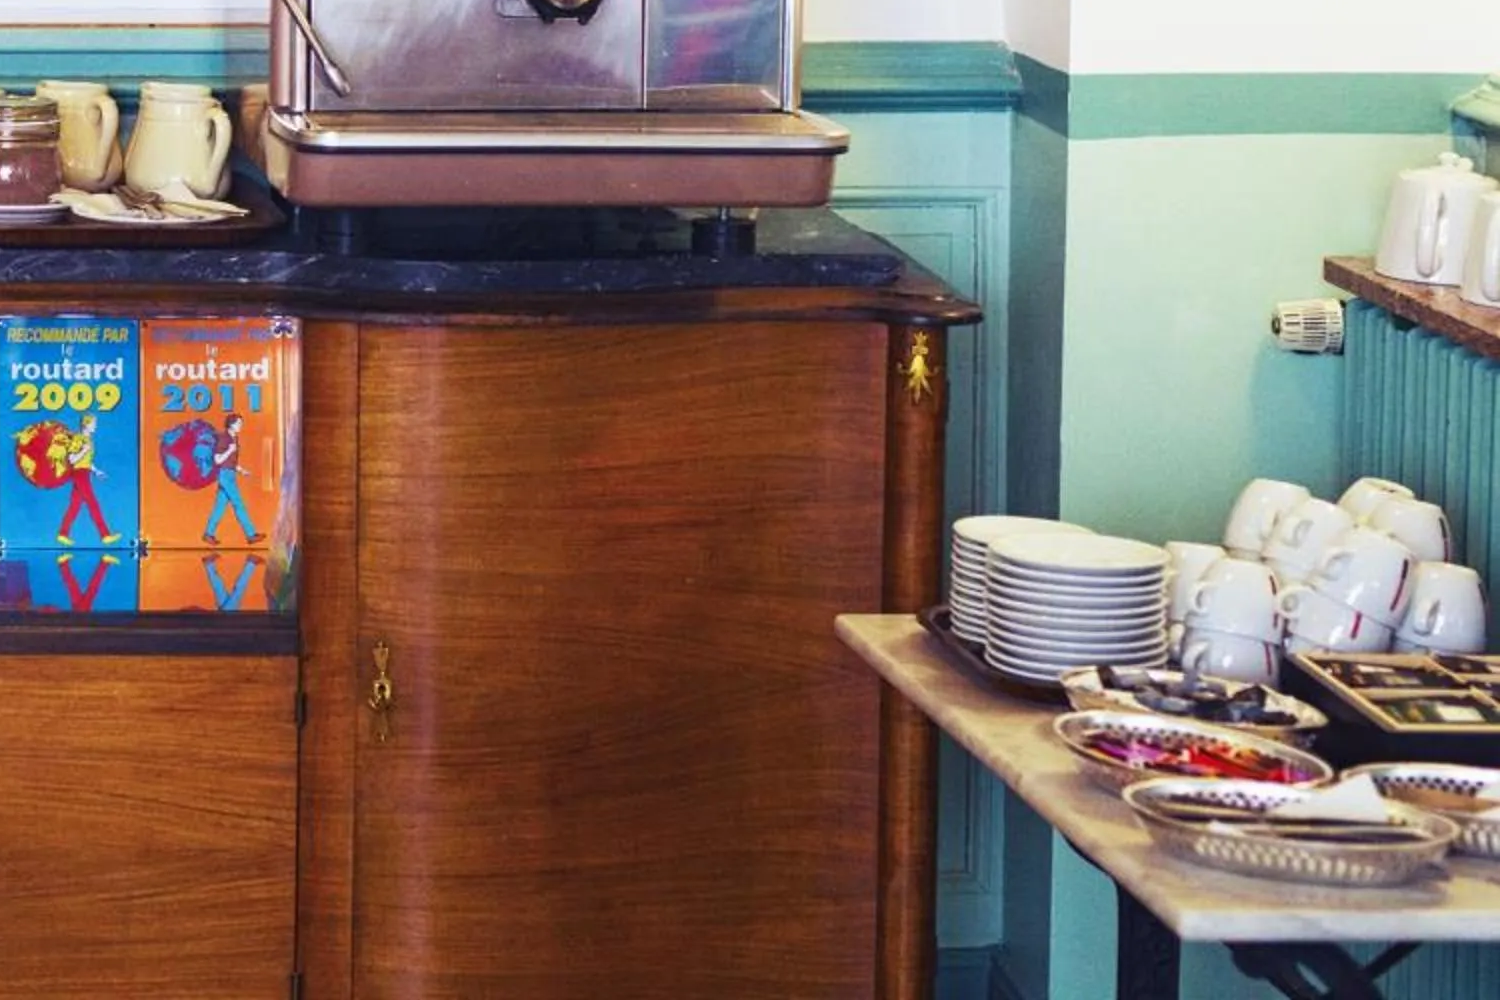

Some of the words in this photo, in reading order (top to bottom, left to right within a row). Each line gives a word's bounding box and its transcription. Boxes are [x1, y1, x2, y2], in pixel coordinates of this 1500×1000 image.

[103, 327, 129, 342] PAR
[11, 357, 124, 380] routard
[155, 356, 269, 380] routard
[12, 382, 123, 412] 2009
[162, 383, 262, 412] 2011
